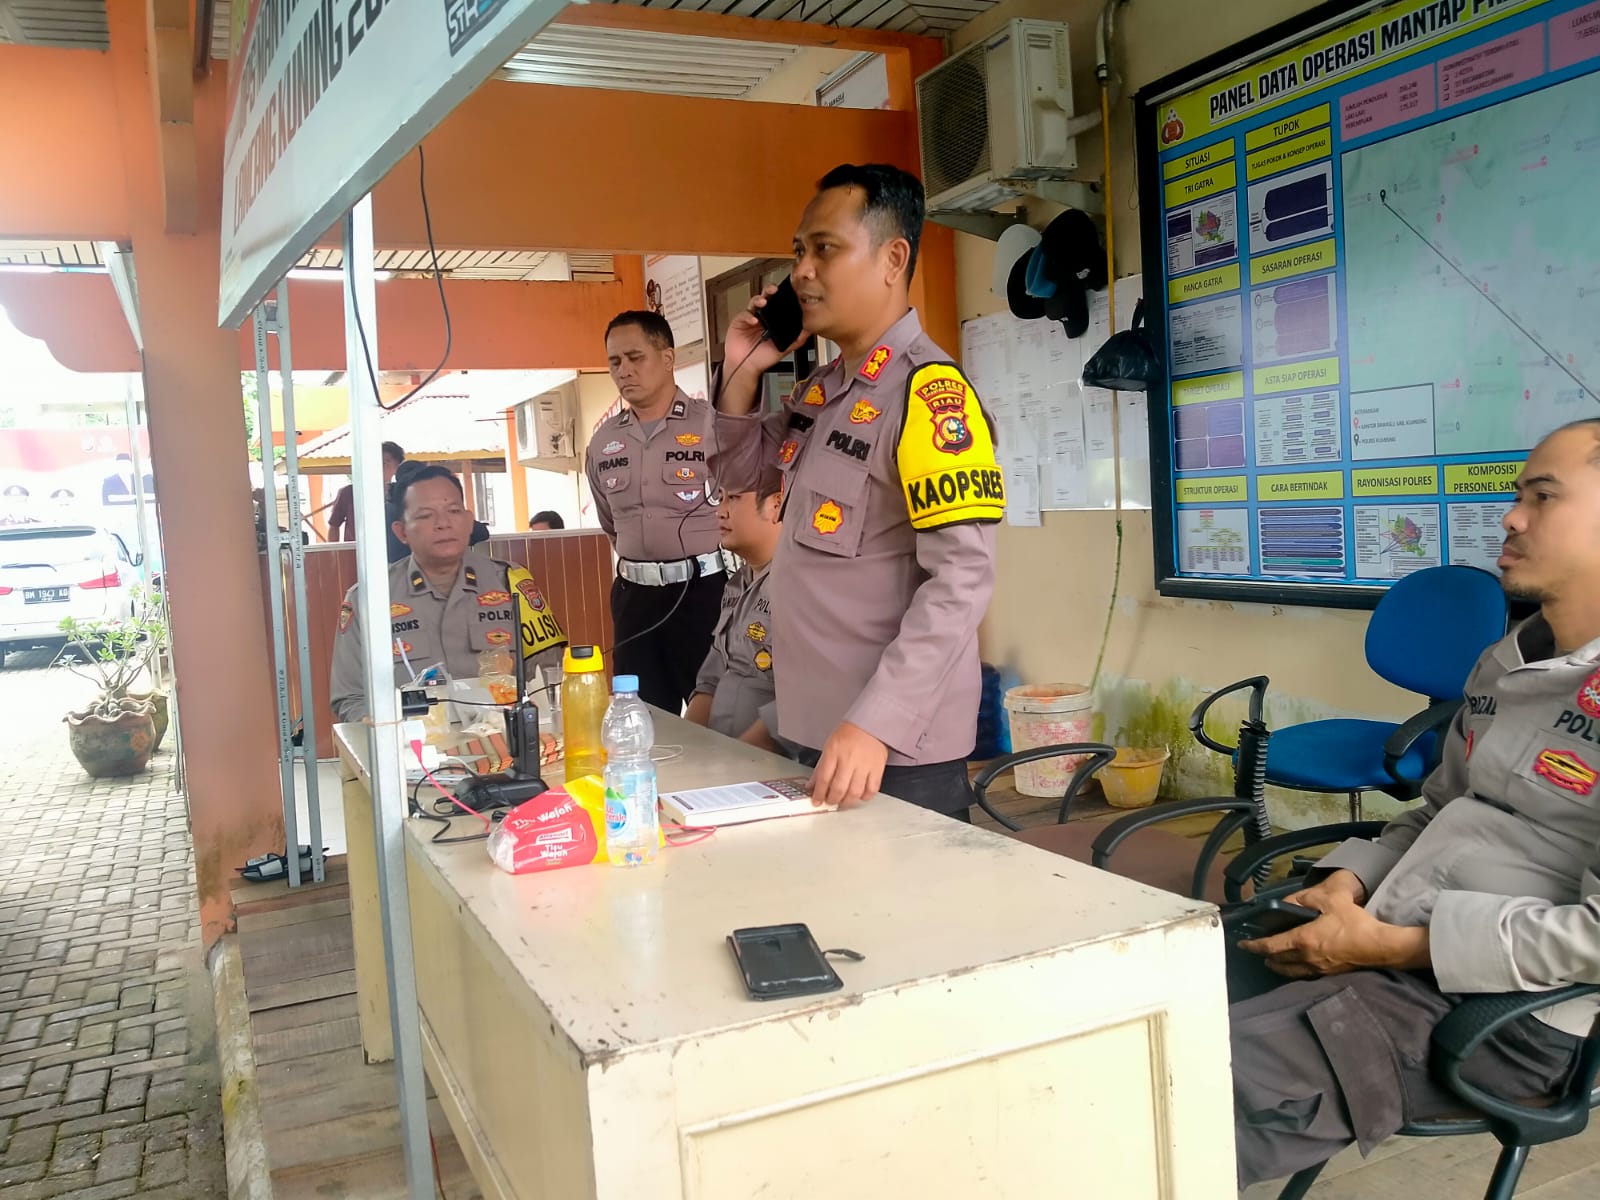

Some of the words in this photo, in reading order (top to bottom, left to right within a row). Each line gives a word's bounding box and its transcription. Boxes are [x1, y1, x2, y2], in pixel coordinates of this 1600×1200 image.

[1209, 80, 1255, 119] PANEL
[1259, 63, 1298, 98] DATA
[1302, 30, 1375, 81] OPERASI
[1381, 0, 1466, 50] MANTAP
[277, 0, 343, 159] KUNING
[1273, 119, 1300, 137] TUPOK
[1185, 152, 1210, 168] SITUASI
[1266, 155, 1282, 165] POKOK
[1287, 146, 1305, 158] KONSEP
[1305, 140, 1326, 152] OPERASI
[1184, 182, 1194, 195] TRI
[1194, 178, 1214, 192] GATRA
[1262, 257, 1292, 274] SASARAN
[1293, 251, 1322, 267] OPERASI
[1183, 281, 1202, 293] PANCA
[1203, 276, 1223, 289] GATRA
[1264, 375, 1281, 386] ASTA
[1281, 373, 1296, 384] SIAP
[1297, 368, 1327, 380] OPERASI
[921, 380, 964, 395] POLRES
[932, 398, 962, 408] RIAU
[826, 430, 871, 461] POLRI
[598, 457, 629, 472] FRANS
[665, 451, 705, 462] POLRI
[1468, 464, 1517, 476] KOMPOSISI
[1183, 486, 1213, 495] STRUKTUR
[1213, 484, 1239, 494] OPERASI
[1271, 483, 1289, 492] CARA
[1289, 481, 1328, 491] BERTINDAK
[1357, 477, 1401, 488] RAYONISASI
[1402, 475, 1433, 487] POLRES
[1453, 482, 1498, 493] PERSONEL
[907, 469, 1004, 513] KAOPSRES
[1553, 709, 1600, 745] POL
[536, 803, 573, 823] Wajah
